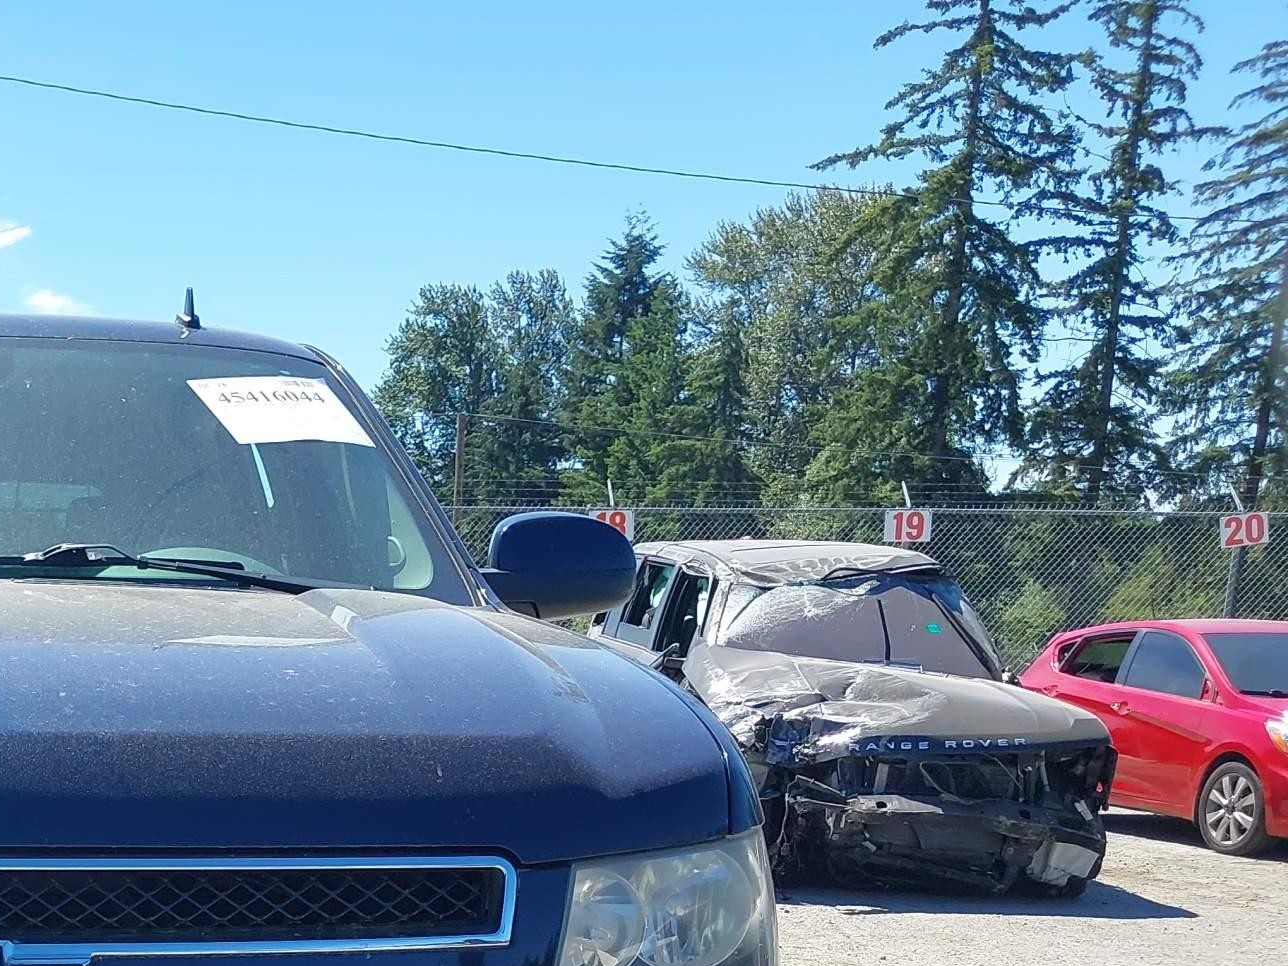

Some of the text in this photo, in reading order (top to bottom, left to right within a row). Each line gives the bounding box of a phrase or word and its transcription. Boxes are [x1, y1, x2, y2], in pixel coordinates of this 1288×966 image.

[218, 390, 325, 404] 45416044
[893, 511, 925, 541] 19
[1224, 513, 1265, 547] 20
[848, 738, 1028, 751] RANGE ROVER
